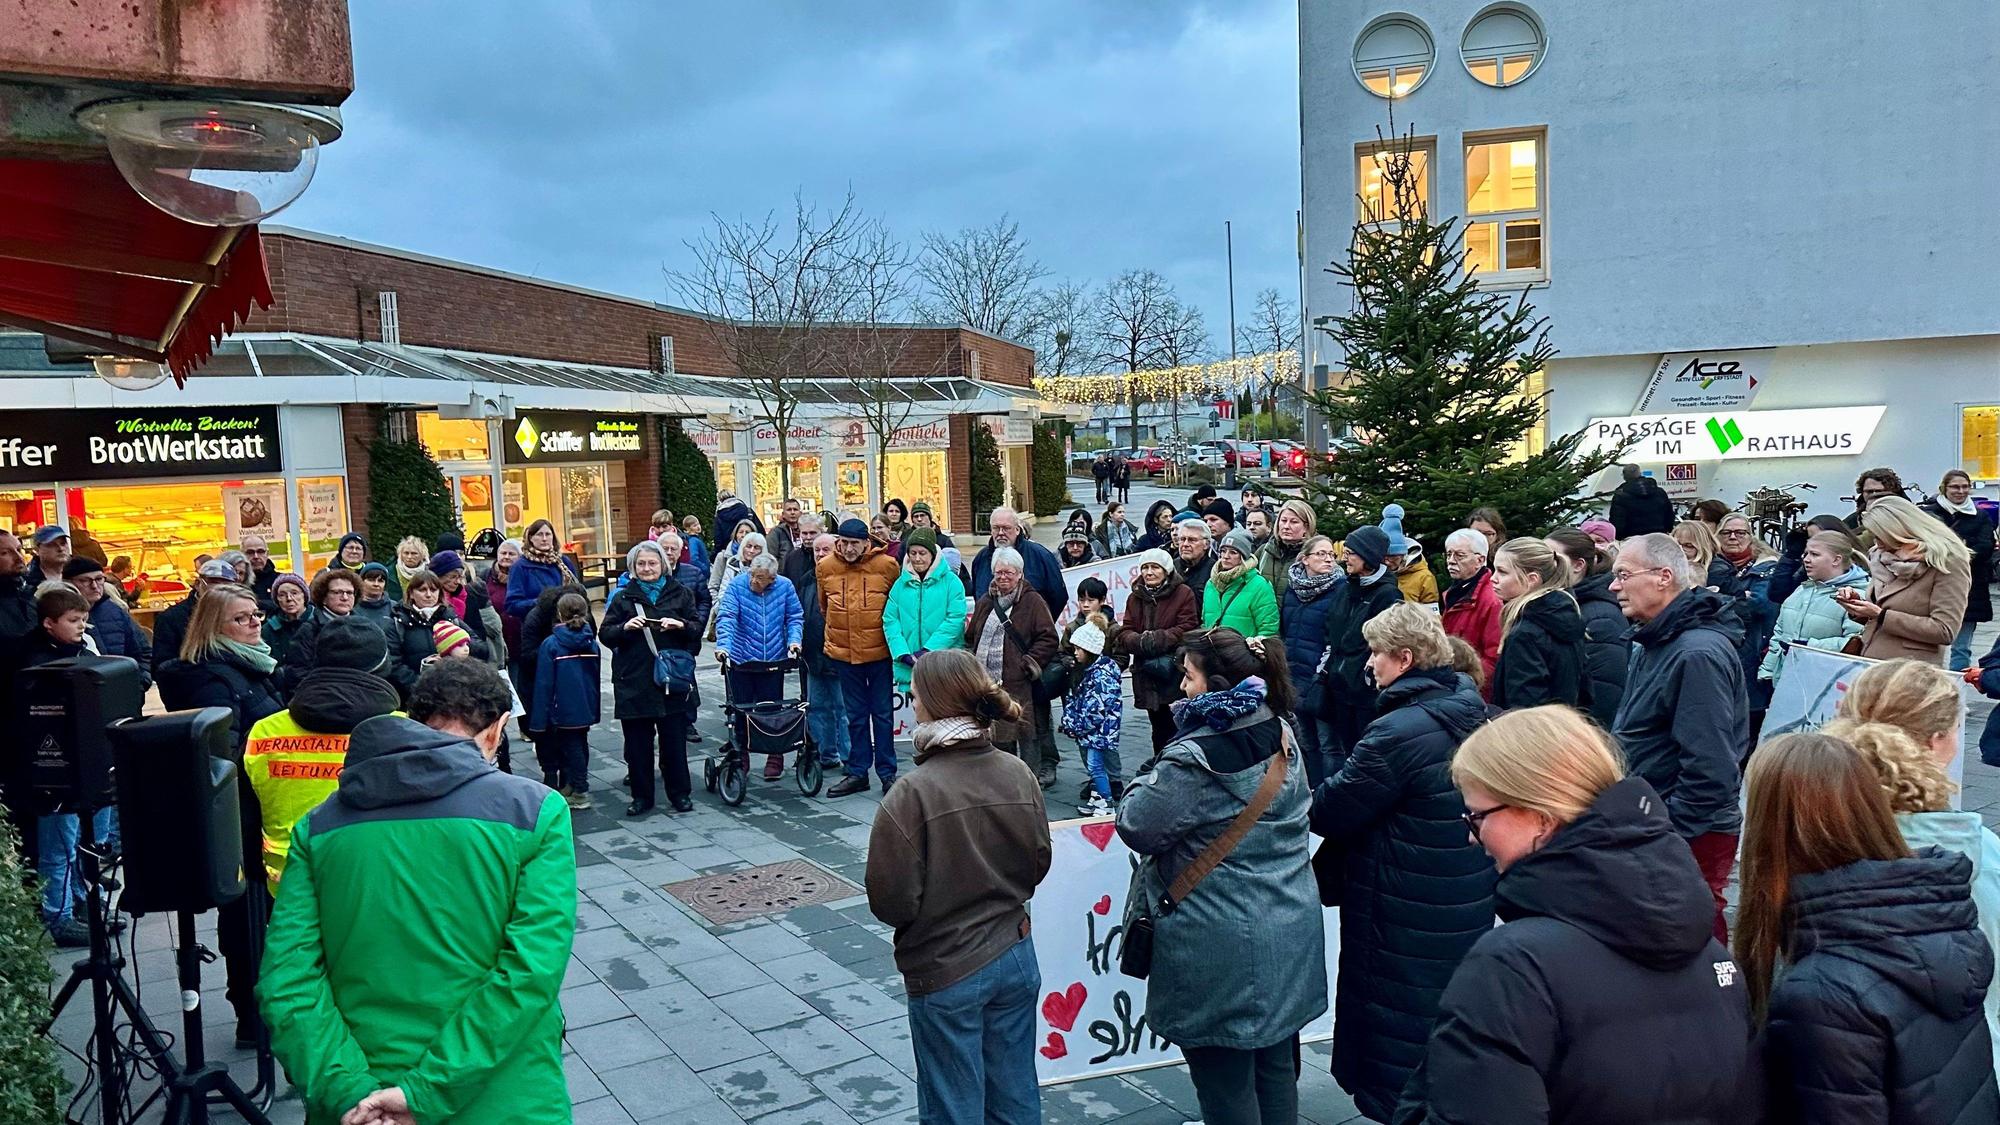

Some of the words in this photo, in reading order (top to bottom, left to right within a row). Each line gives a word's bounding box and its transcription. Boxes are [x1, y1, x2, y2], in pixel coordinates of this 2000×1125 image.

[115, 417, 193, 433] Wertvolles
[198, 416, 260, 431] Backen!
[756, 426, 822, 440] Gesndheit
[1599, 420, 1697, 438] PASSAGE
[540, 431, 583, 452] Schiffer
[589, 431, 640, 451] BrotWerkstatt
[892, 423, 947, 444] potheke
[89, 433, 265, 464] BrotWerkstatt
[1655, 440, 1681, 454] IM
[1748, 433, 1852, 452] RATHAUS
[1667, 464, 1696, 479] Köhl
[330, 493, 336, 501] 5
[312, 506, 328, 514] Zahl
[329, 505, 334, 513] 4
